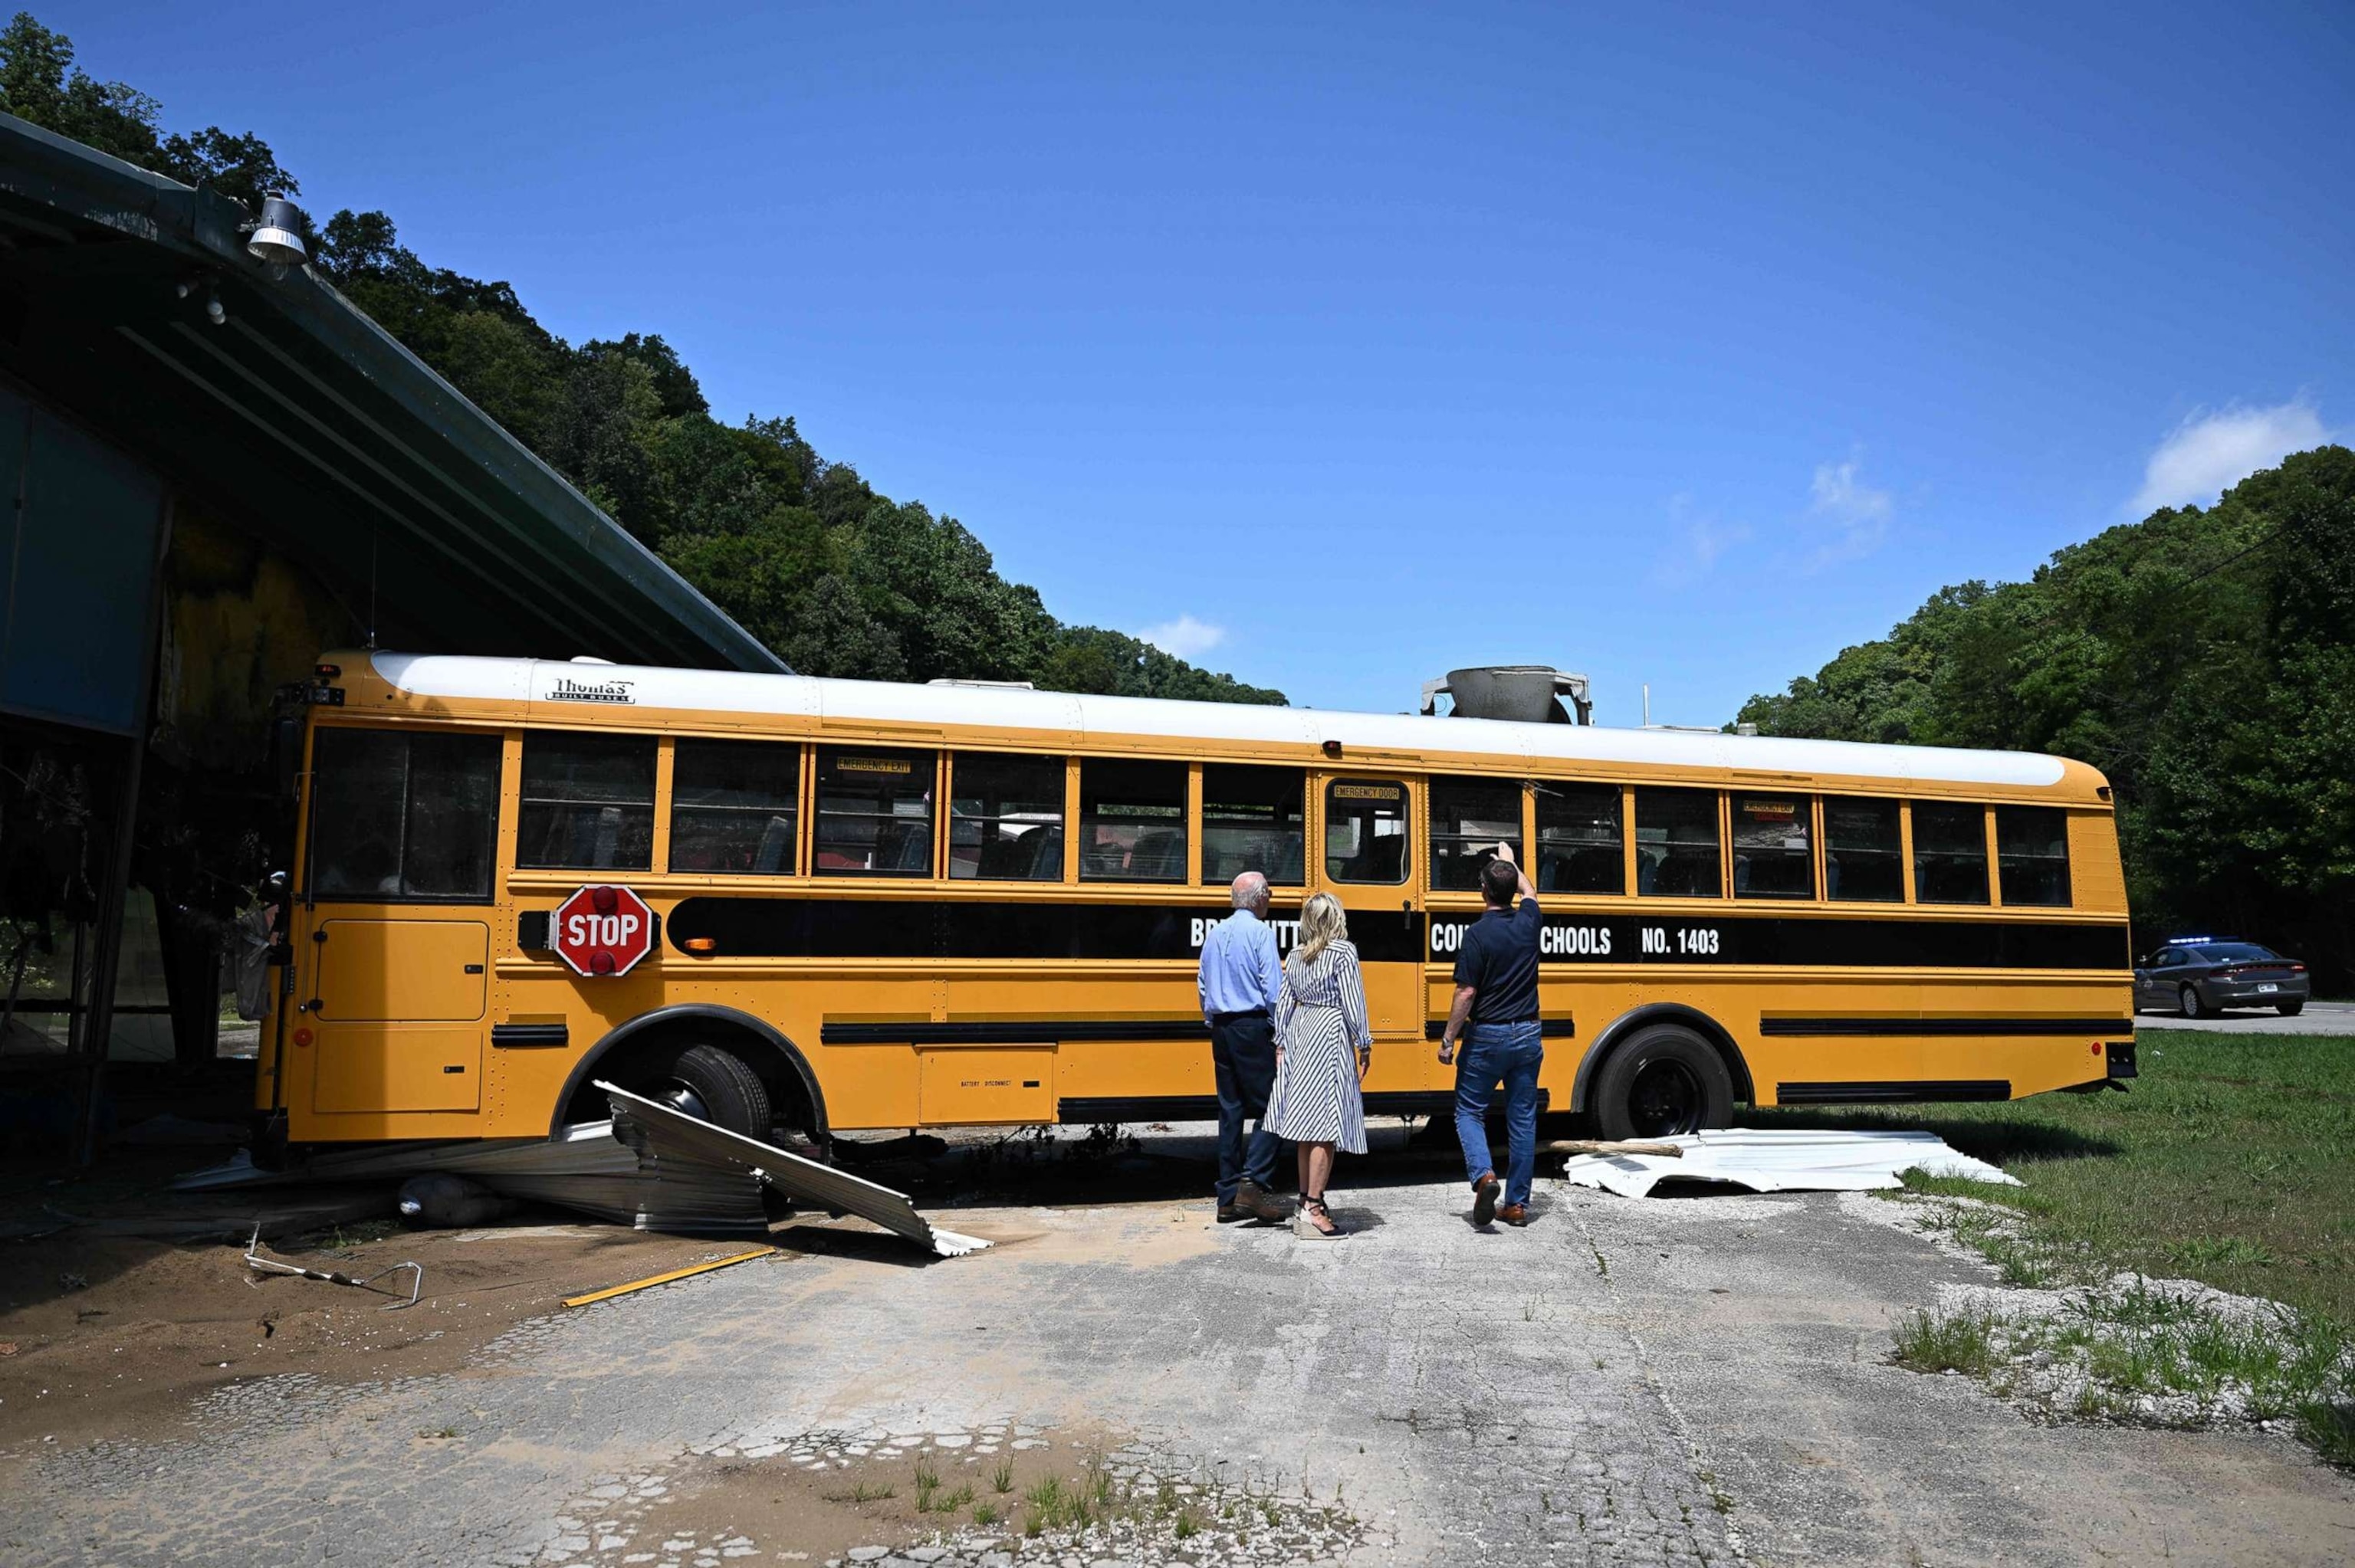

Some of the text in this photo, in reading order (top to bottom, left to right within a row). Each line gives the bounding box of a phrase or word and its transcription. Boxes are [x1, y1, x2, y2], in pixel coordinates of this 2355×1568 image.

[554, 678, 634, 694] Thomas
[838, 758, 908, 773] EMERGENCY EXIT
[1336, 786, 1398, 799] EMERGENCY DOOR
[568, 914, 639, 946] STOP
[1540, 926, 1611, 954] CHOOLS
[1642, 928, 1671, 953] NO.
[1677, 929, 1719, 954] 1403
